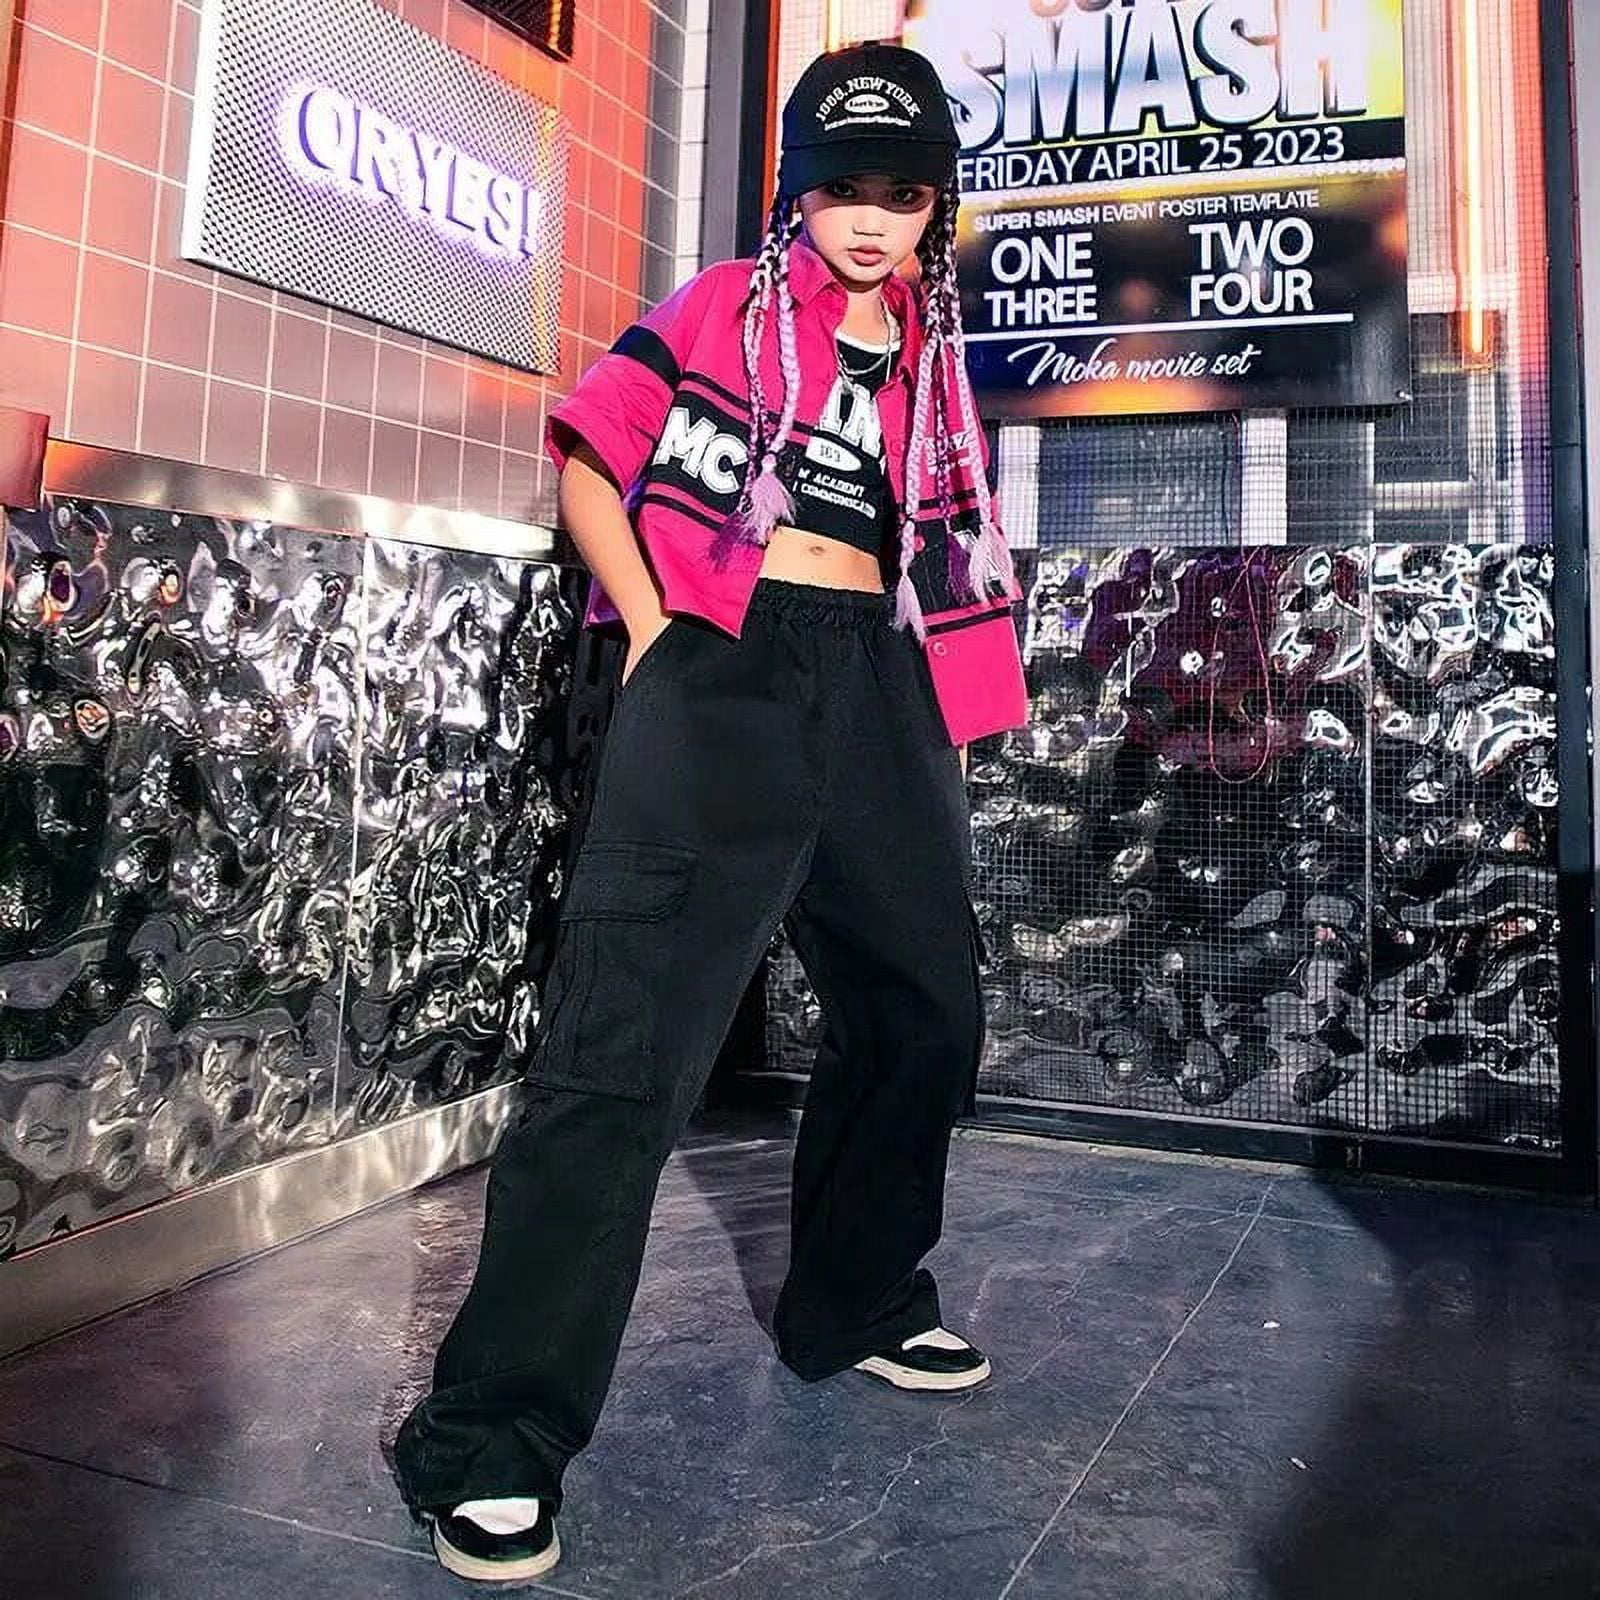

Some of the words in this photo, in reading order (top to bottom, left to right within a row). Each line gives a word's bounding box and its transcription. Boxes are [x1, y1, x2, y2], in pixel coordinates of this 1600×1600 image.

[945, 0, 1366, 153] SMASH
[956, 148, 1082, 192] FRIDAY
[1088, 138, 1191, 180] APRIL
[1199, 136, 1243, 171] 25
[1252, 126, 1345, 167] 2023
[974, 211, 1032, 233] SUPER
[1033, 205, 1100, 227] SMASH
[1102, 201, 1156, 223] EVENT
[1158, 197, 1228, 219] POSTER
[1230, 189, 1320, 213] TEMPLATE
[990, 232, 1094, 284] ONE
[1189, 217, 1313, 270] TWO
[983, 285, 1098, 328] THREE
[1189, 270, 1314, 318] FOUR
[1006, 337, 1121, 386] Moka
[1124, 349, 1206, 381] movie
[1213, 343, 1262, 375] set
[651, 406, 749, 494] MC
